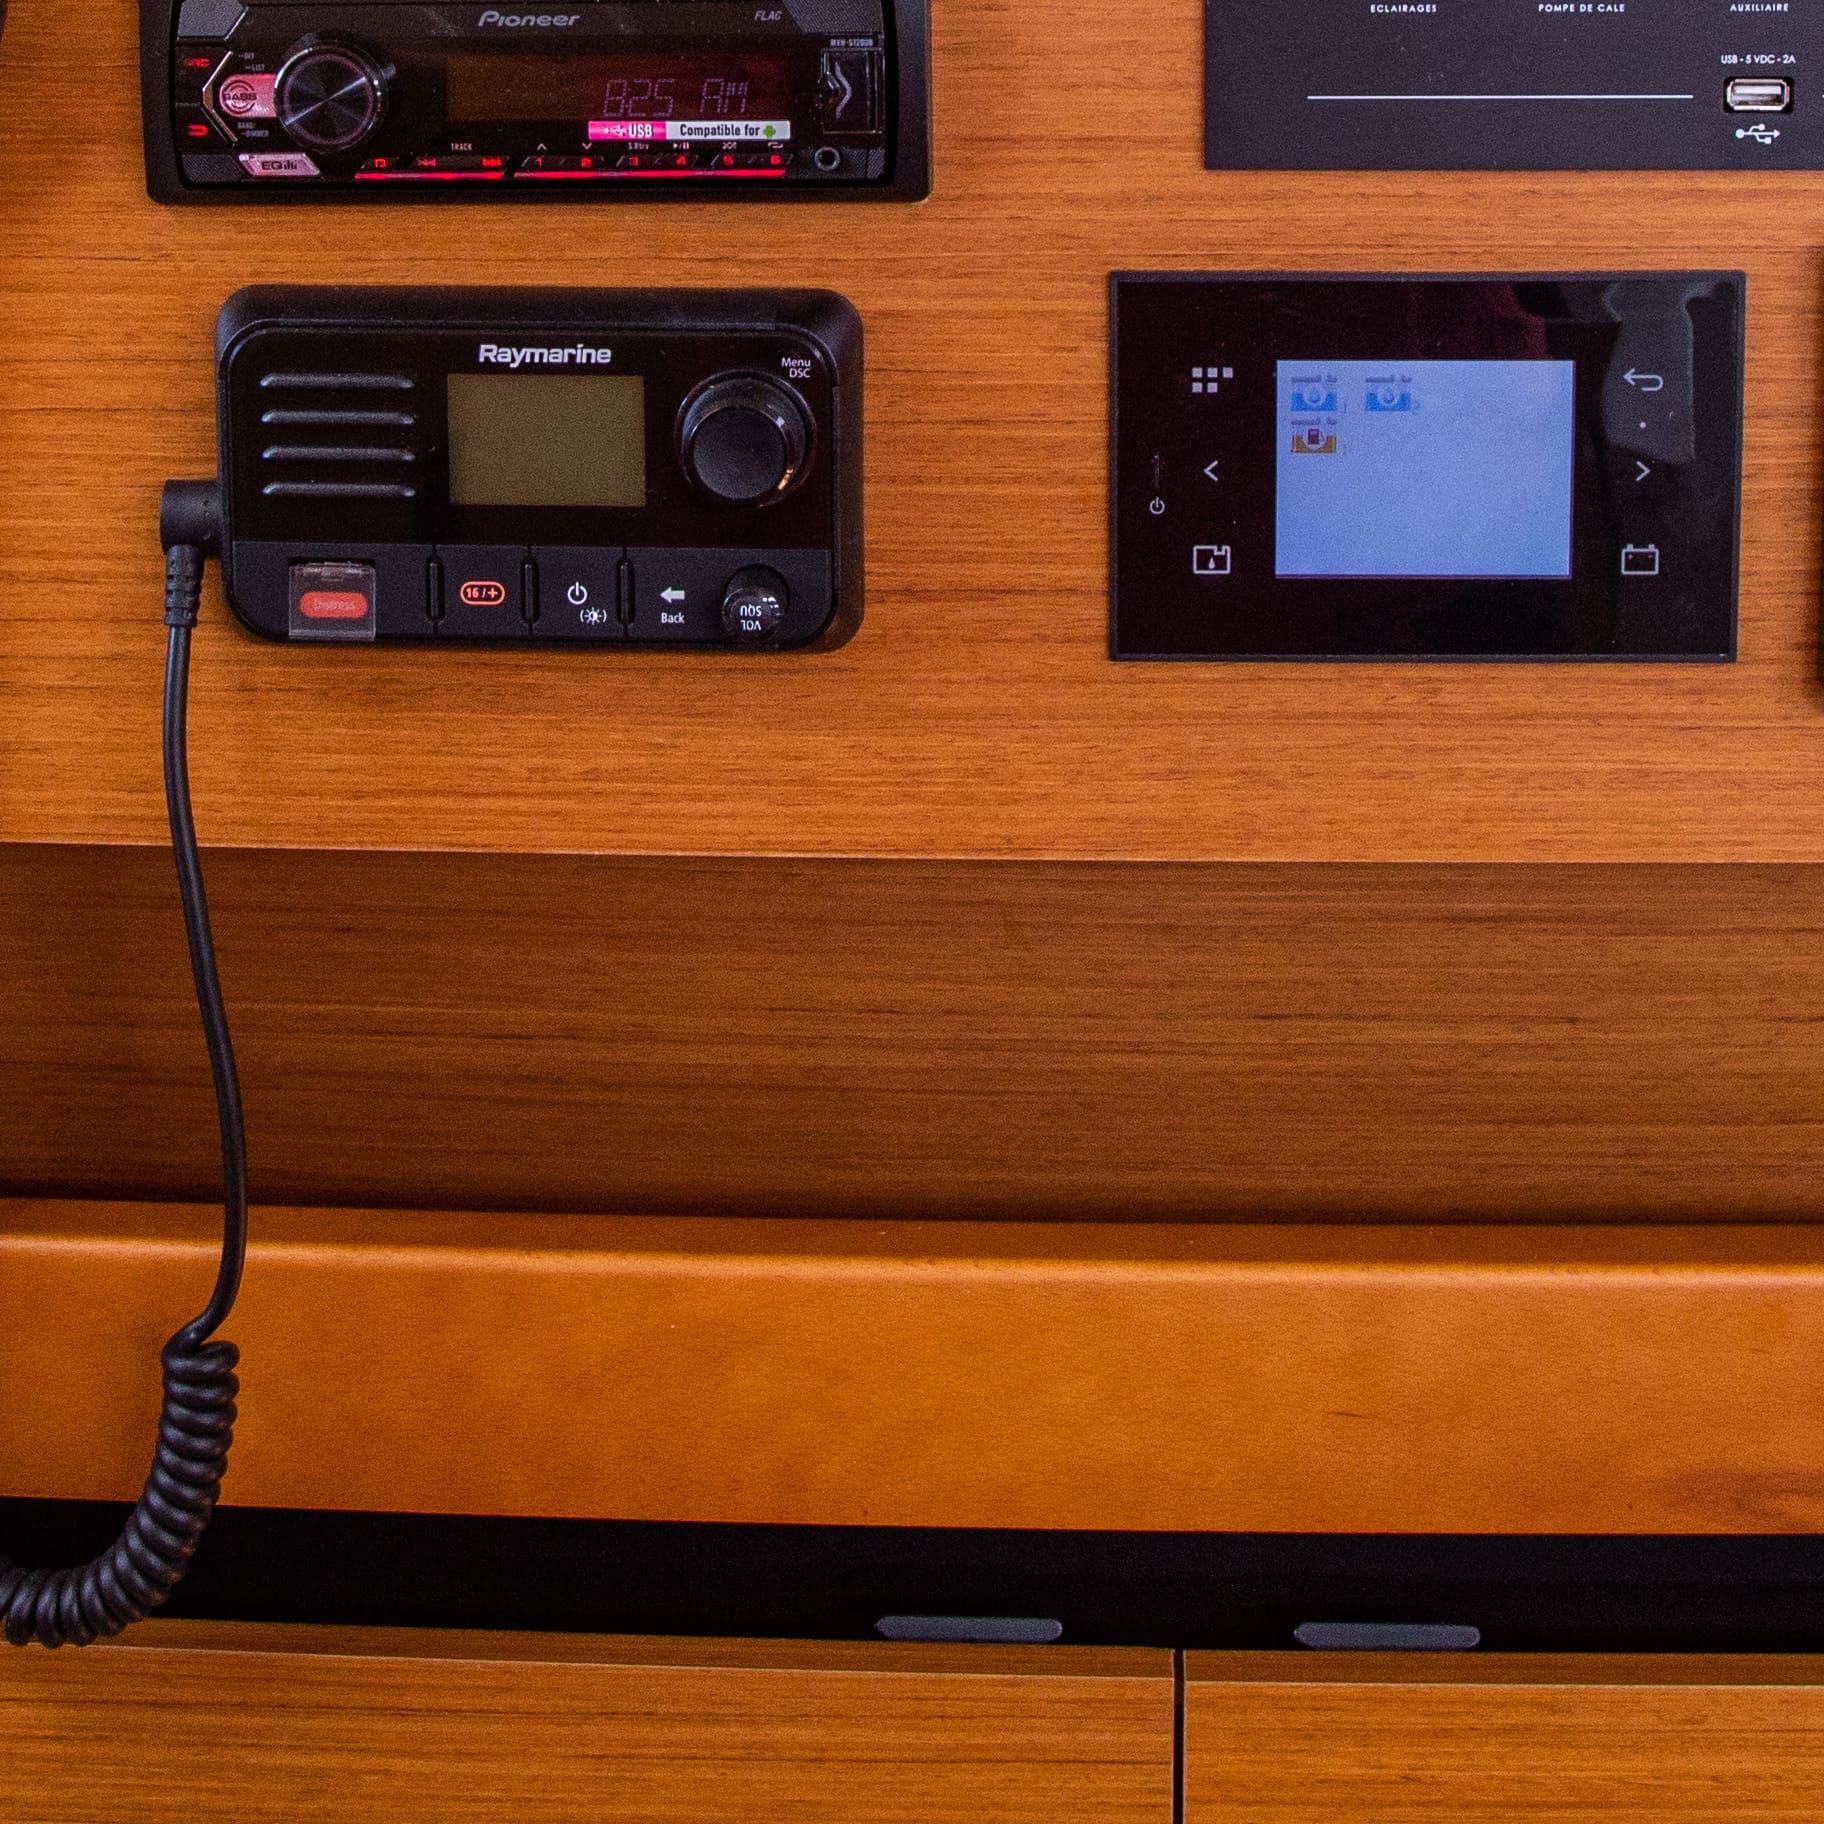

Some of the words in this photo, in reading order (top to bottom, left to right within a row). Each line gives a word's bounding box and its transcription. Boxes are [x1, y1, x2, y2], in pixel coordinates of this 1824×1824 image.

[1371, 4, 1436, 13] ECLAIRAGES
[1538, 4, 1574, 12] POMPE
[1580, 4, 1592, 12] DE
[1598, 4, 1624, 12] CALE
[1730, 3, 1788, 11] AUXILIAIRE
[478, 10, 581, 27] Pioneer
[754, 10, 783, 21] FLAC
[1720, 55, 1738, 64] USB
[1745, 55, 1752, 64] 5
[1753, 55, 1775, 64] VDC
[1782, 55, 1796, 64] 2A
[628, 124, 653, 138] USB
[679, 123, 741, 138] Compatible
[744, 124, 761, 136] for
[450, 142, 473, 152] TRACK
[479, 344, 612, 367] Raymarine
[781, 357, 811, 367] Menu
[789, 367, 811, 378] DSC
[314, 597, 356, 611] Distress
[661, 612, 685, 624] Back
